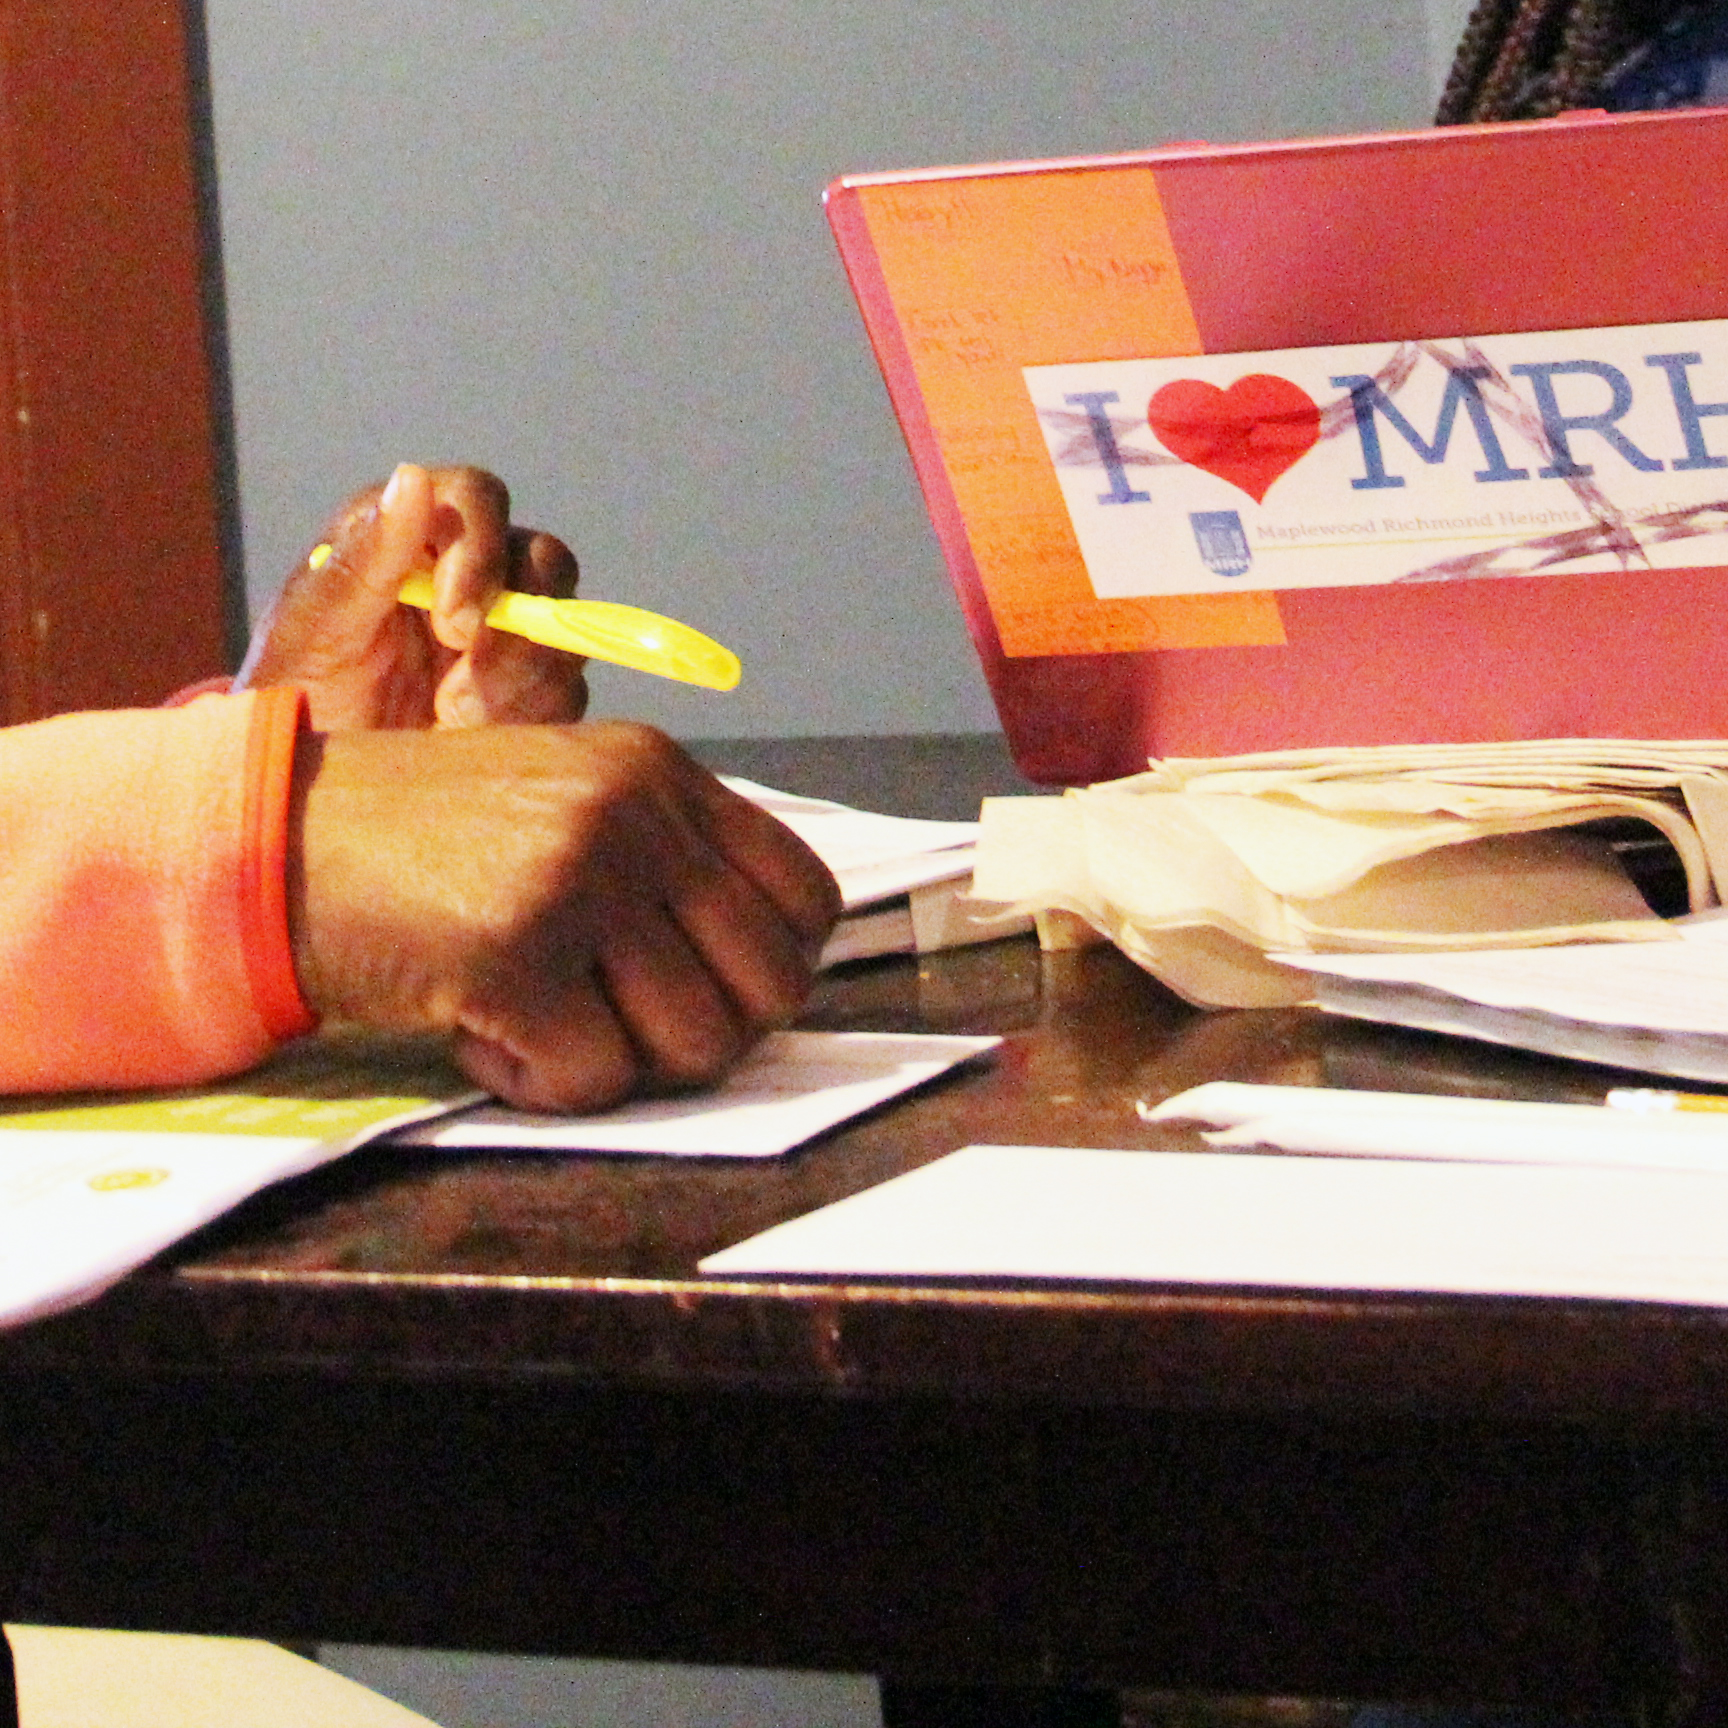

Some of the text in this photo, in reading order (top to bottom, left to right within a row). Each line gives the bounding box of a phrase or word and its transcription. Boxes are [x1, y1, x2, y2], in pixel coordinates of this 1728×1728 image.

[1063, 390, 1151, 505] I
[1256, 518, 1376, 542] Maplewood
[1381, 512, 1493, 534] Richmond
[1498, 506, 1582, 528] Heights
